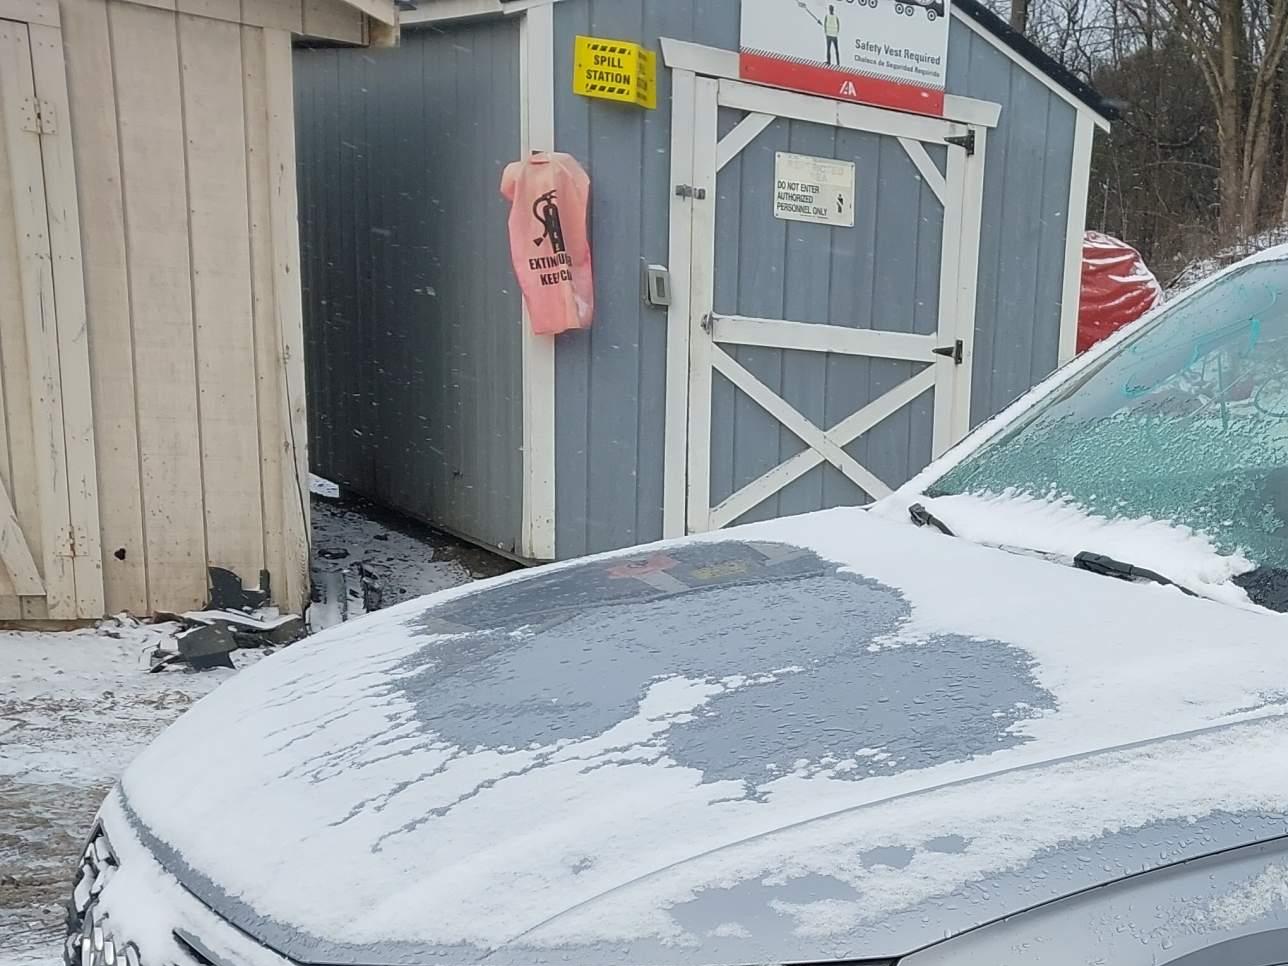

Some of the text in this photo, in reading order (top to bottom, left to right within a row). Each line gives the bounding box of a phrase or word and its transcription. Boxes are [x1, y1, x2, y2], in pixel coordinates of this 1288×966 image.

[855, 39, 941, 65] Safety Vest Required
[593, 54, 624, 69] SPILL
[585, 69, 631, 85] STATION
[777, 180, 820, 194] DO NOT ENTER
[777, 191, 813, 203] AUTHORIZED
[776, 202, 828, 216] PERSONNEL ONLY
